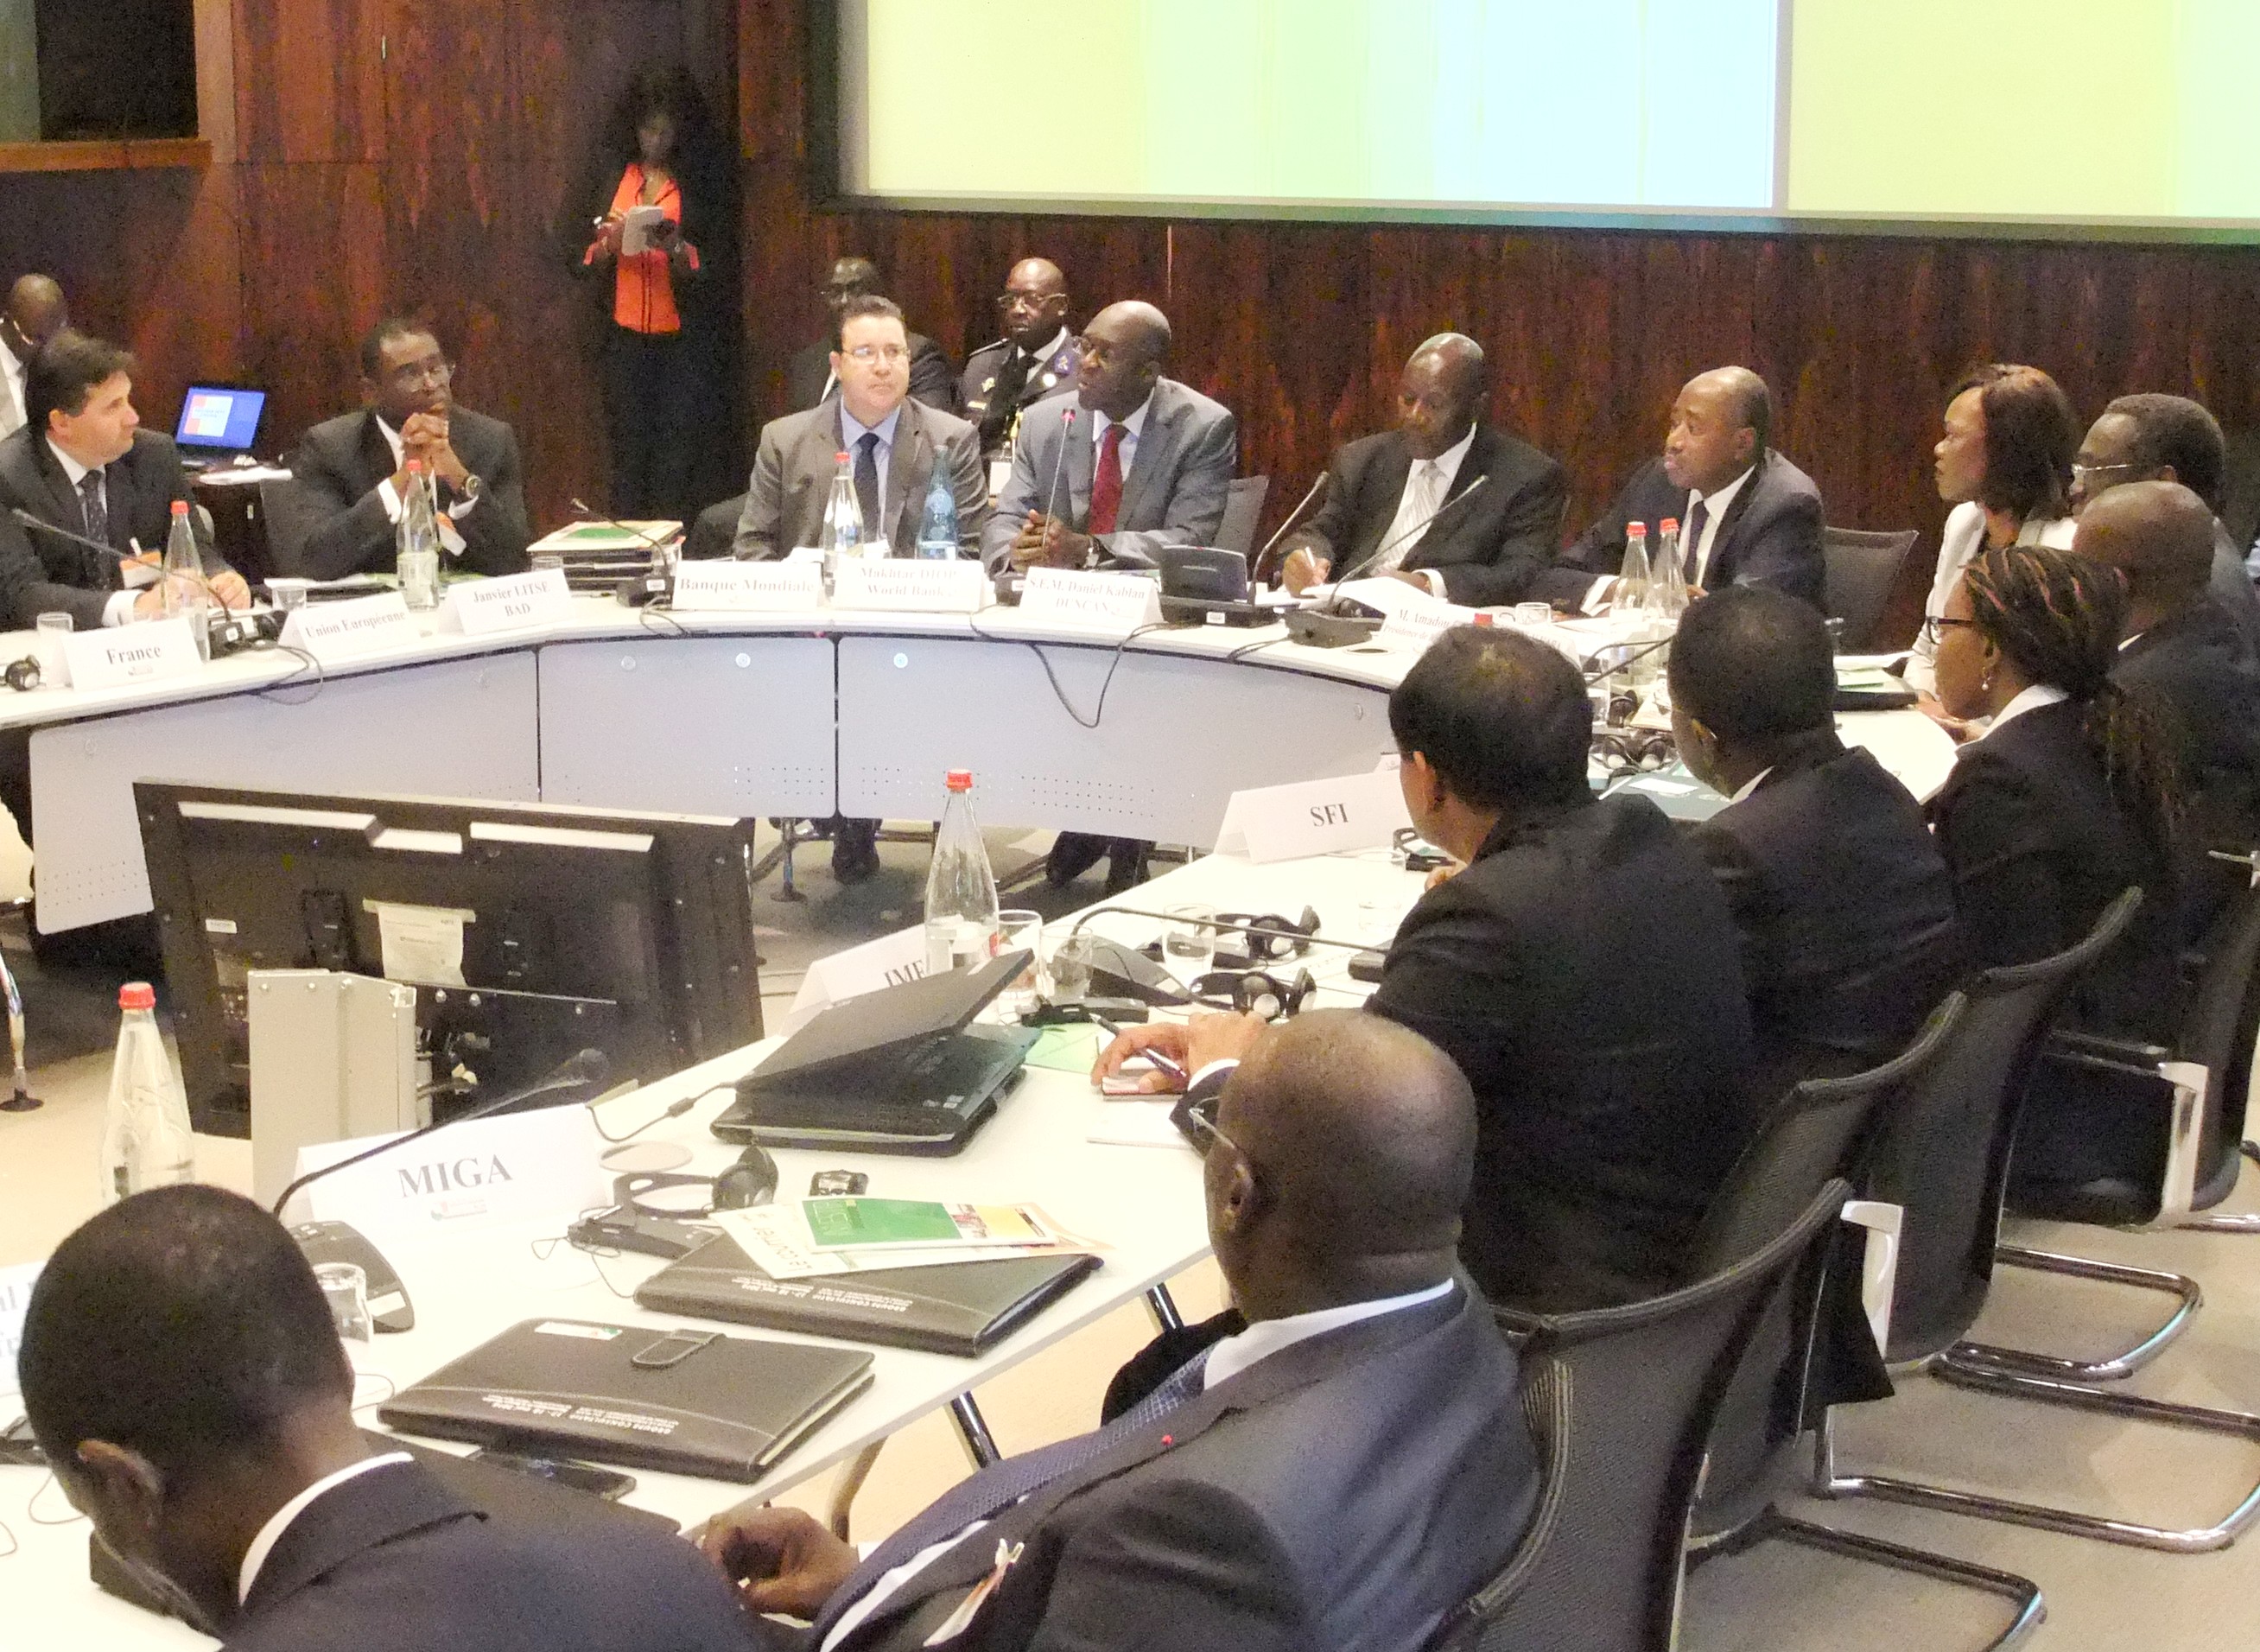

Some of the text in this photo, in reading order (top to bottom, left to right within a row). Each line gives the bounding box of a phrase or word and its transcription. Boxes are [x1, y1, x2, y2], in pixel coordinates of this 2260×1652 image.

[860, 567, 916, 579] Makhtar
[680, 578, 814, 593] Banque Mondiale
[867, 584, 944, 597] World Bank
[1068, 580, 1103, 594] Daniel
[1106, 584, 1146, 599] Kablan
[473, 588, 513, 604] Janvier
[505, 602, 531, 618] BAD
[1056, 597, 1108, 612] DUNCAN
[305, 611, 406, 639] Union Européenne
[106, 645, 162, 665] France
[1309, 804, 1349, 827] SFI
[397, 1154, 513, 1198] MIGA
